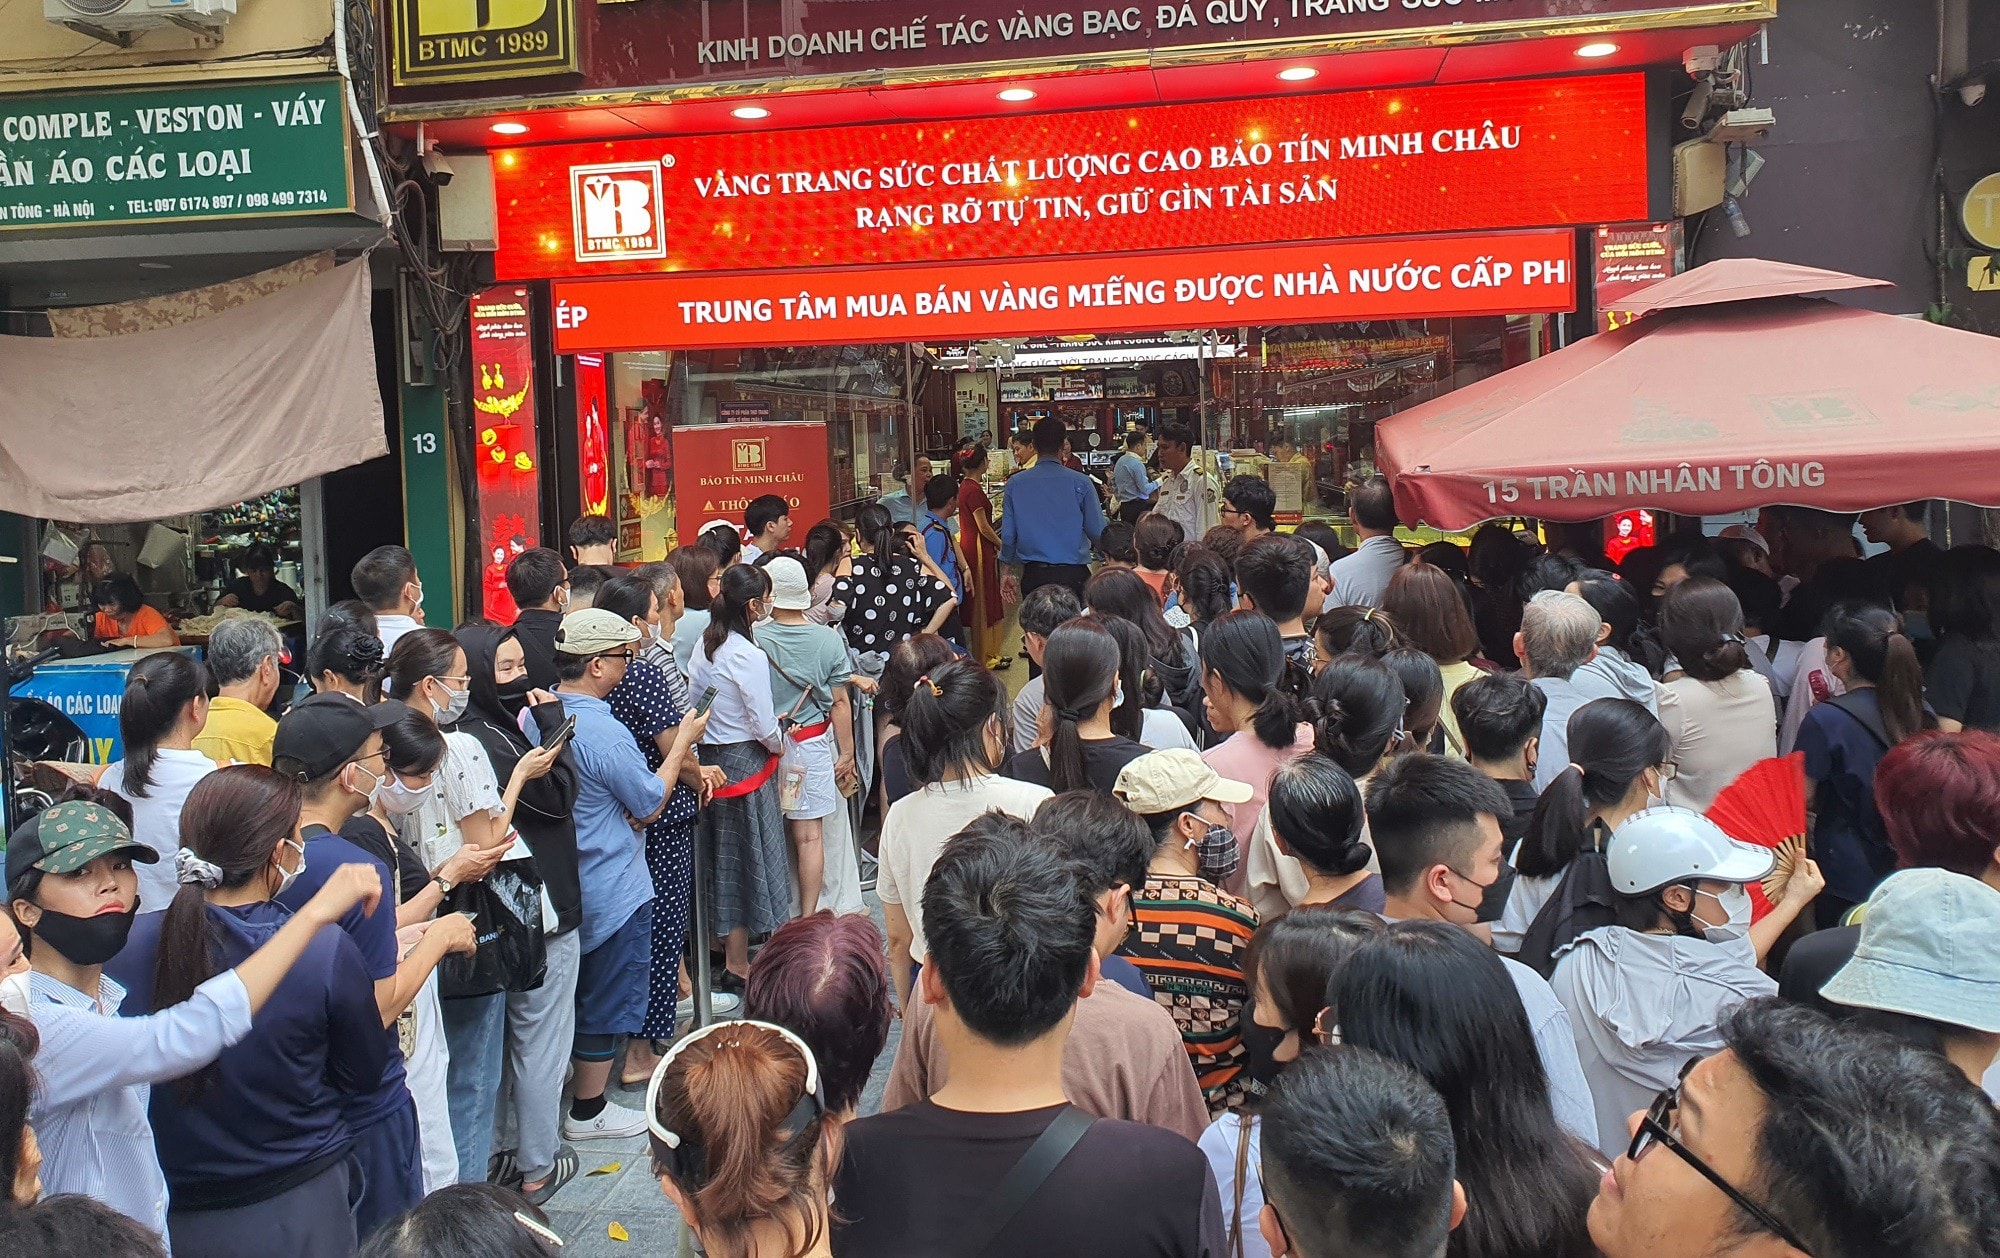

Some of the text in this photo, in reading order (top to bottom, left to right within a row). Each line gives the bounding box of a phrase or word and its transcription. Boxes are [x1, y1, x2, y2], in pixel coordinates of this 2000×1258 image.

[419, 30, 549, 61] BTMC 1989
[698, 37, 759, 64] KINH
[769, 29, 864, 58] DOANH
[870, 15, 928, 51] CHẾ
[936, 14, 989, 46] TÁC
[997, 10, 1074, 41] VÀNG
[1156, 0, 1198, 29] ĐÁ
[4, 111, 113, 142] COMPLE
[136, 104, 243, 134] VESTON
[271, 92, 326, 126] VÁY
[49, 150, 94, 185] ÁO
[106, 146, 167, 181] CÁC
[178, 149, 251, 182] LOẠI
[694, 120, 1521, 198] VÀNG TRANG SỨC CHẤT LƯỢNG CAO BẢO TÍN MINH CHÂU
[10, 202, 42, 219] TÔNG
[54, 201, 71, 218] HÀ
[73, 201, 94, 219] NỘI
[180, 196, 209, 210] 6174
[212, 195, 234, 209] 897
[246, 193, 269, 207] 098
[271, 192, 294, 206] 499
[297, 190, 328, 204] 7314
[855, 174, 1339, 233] RẠNG RỠ TỰ TIN, GIỮ GÌN TÀI SẢN
[555, 256, 1570, 329] ÉP TRUNG TÂM MUA BÁN VÀNG MIẾNG ĐƯỢC NHÀ NƯỚC CẤP PH
[412, 433, 437, 454] 13
[724, 474, 742, 485] TÍN
[745, 475, 773, 484] MINH
[775, 472, 805, 483] CHÂU
[1483, 458, 1825, 503] 15 TRẦN NHÂN TÔNG
[66, 691, 93, 715] CÁC
